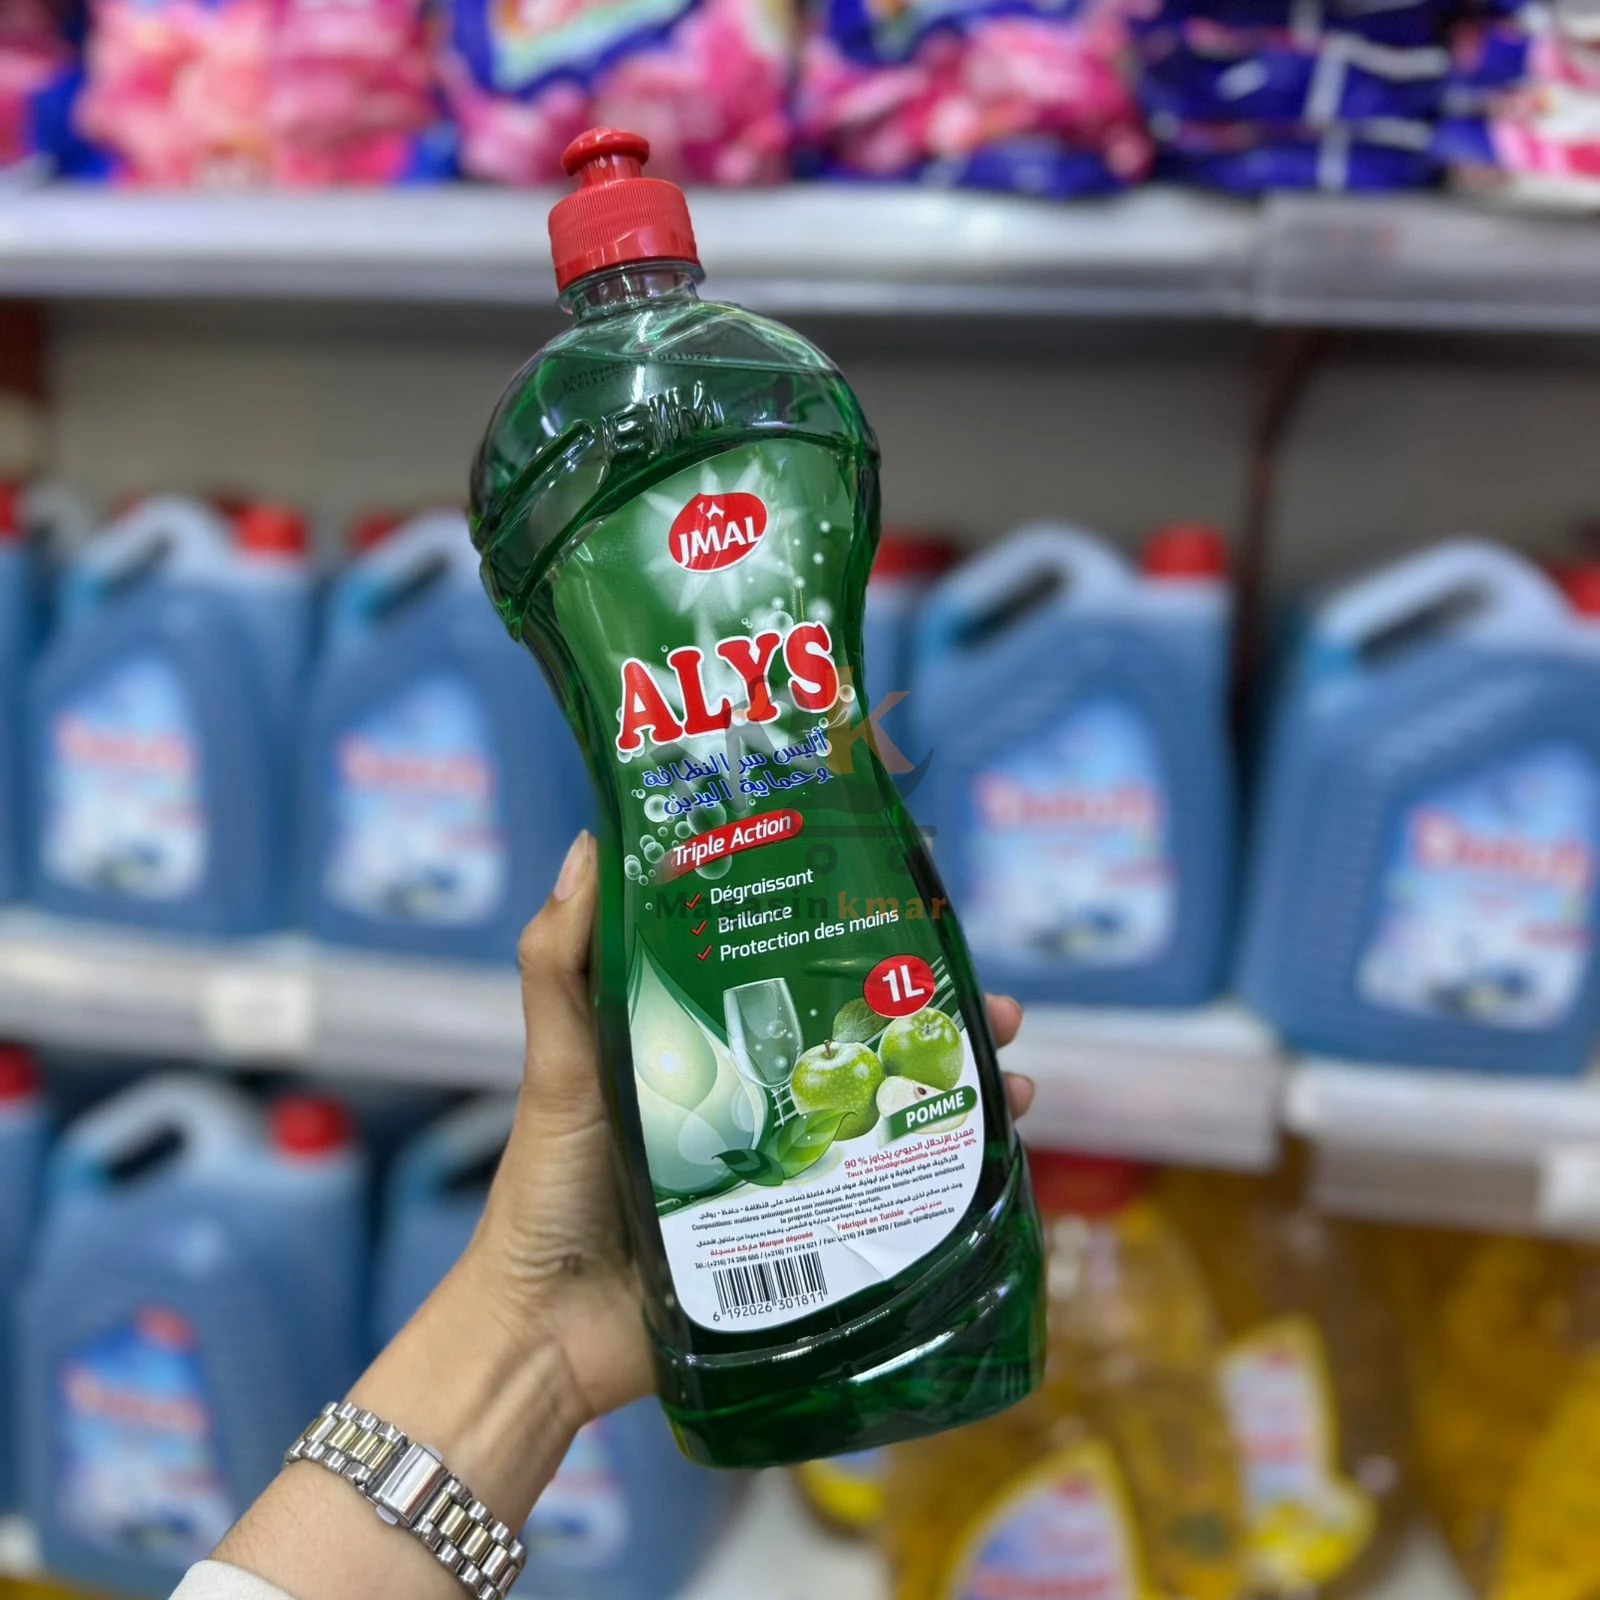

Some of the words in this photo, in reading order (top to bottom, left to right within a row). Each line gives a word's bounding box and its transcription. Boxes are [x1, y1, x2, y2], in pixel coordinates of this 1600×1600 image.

[678, 516, 762, 567] JMAL
[616, 622, 840, 751] ALYS
[773, 726, 829, 764] أليس
[642, 752, 731, 787] النظافة
[737, 751, 767, 774] سر
[739, 766, 830, 796] وحماية
[663, 779, 733, 815] اليدين
[673, 836, 725, 866] Triple
[730, 815, 791, 848] Action
[710, 868, 814, 905] Dégraissant
[718, 906, 792, 933] Brillance
[720, 930, 810, 962] Protection
[814, 923, 845, 941] des
[849, 909, 900, 932] mains
[882, 964, 925, 1003] 1L
[905, 1091, 965, 1129] POMME
[953, 1128, 974, 1142] معدل
[844, 1158, 857, 1169] 90
[869, 1151, 893, 1165] يتجاوز
[847, 1169, 863, 1179] Taux
[794, 1205, 801, 1213] et
[837, 1217, 868, 1231] Fabriqué
[879, 1208, 905, 1221] Tunisie
[759, 1239, 785, 1248] Marque
[785, 1231, 814, 1242] déposée
[713, 1311, 721, 1322] 6
[727, 1302, 773, 1319] 192026
[777, 1291, 824, 1310] 301811
